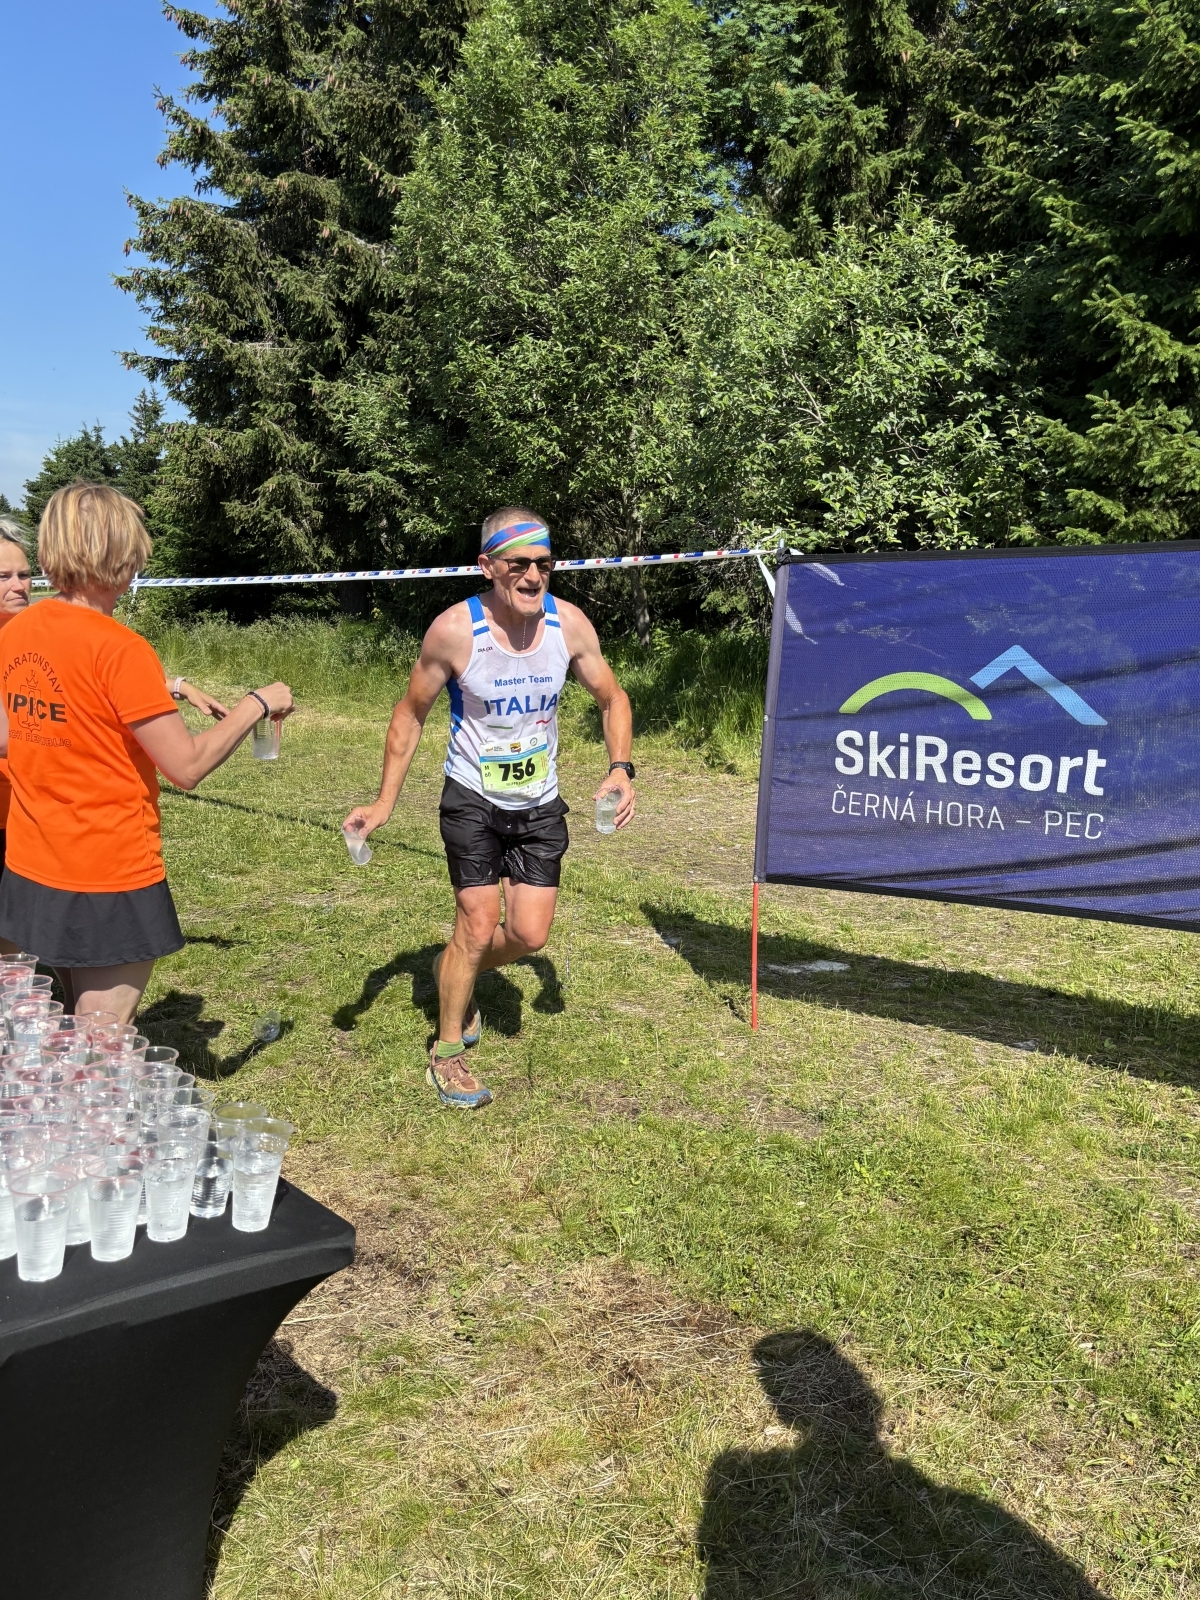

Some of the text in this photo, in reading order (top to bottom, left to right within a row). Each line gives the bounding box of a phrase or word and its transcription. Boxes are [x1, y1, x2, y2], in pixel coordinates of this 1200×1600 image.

[3, 652, 64, 693] MARATONSTAV
[494, 675, 553, 688] Master Team
[483, 693, 558, 717] ITALIA
[26, 732, 72, 748] REPUBLIC
[498, 757, 536, 782] 756
[834, 729, 1107, 796] SkiResort
[831, 783, 916, 823] ČERNÁ
[926, 799, 1005, 831] HORA
[1044, 810, 1104, 840] PEC
